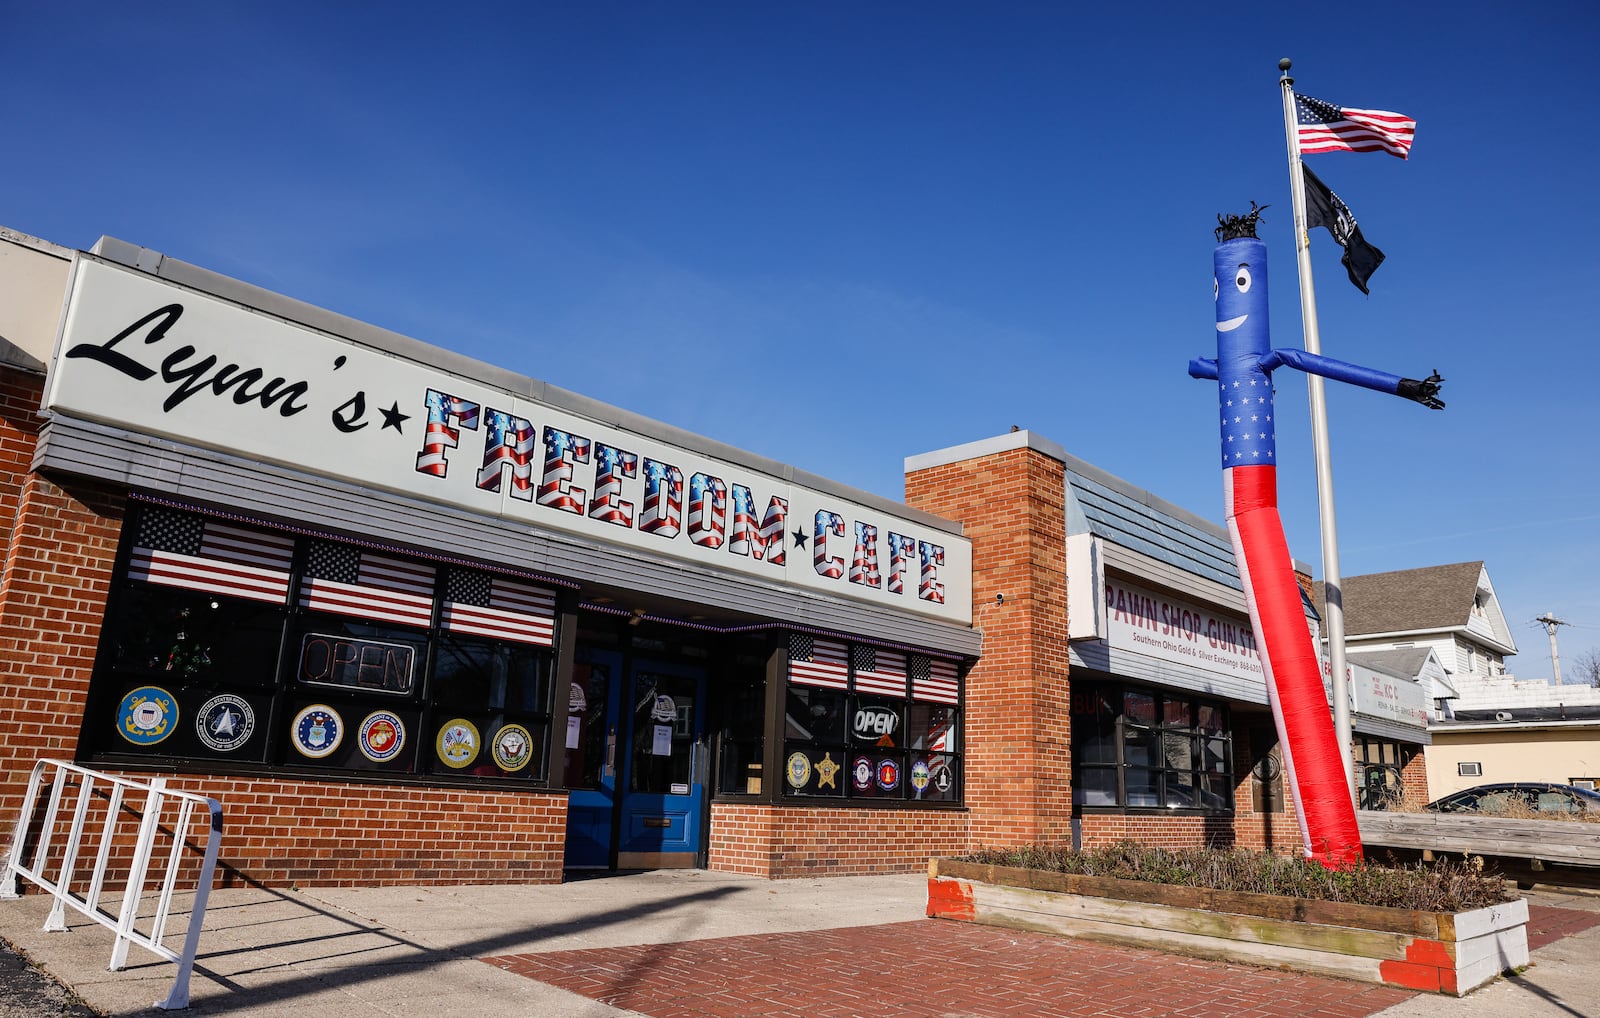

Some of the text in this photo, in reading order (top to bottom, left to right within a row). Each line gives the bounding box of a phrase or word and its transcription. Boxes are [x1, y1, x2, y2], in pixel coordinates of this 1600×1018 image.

[66, 303, 946, 604] Lynn's FREEDOM CAFE
[1105, 585, 1158, 632] PAWN
[1162, 603, 1202, 643] SHOP
[305, 639, 411, 690] OPEN
[1133, 632, 1161, 648] Southern
[1162, 640, 1177, 652] Ohio
[1178, 644, 1191, 656] Gold
[1214, 654, 1238, 669] Exchange
[855, 710, 894, 734] OPEN
